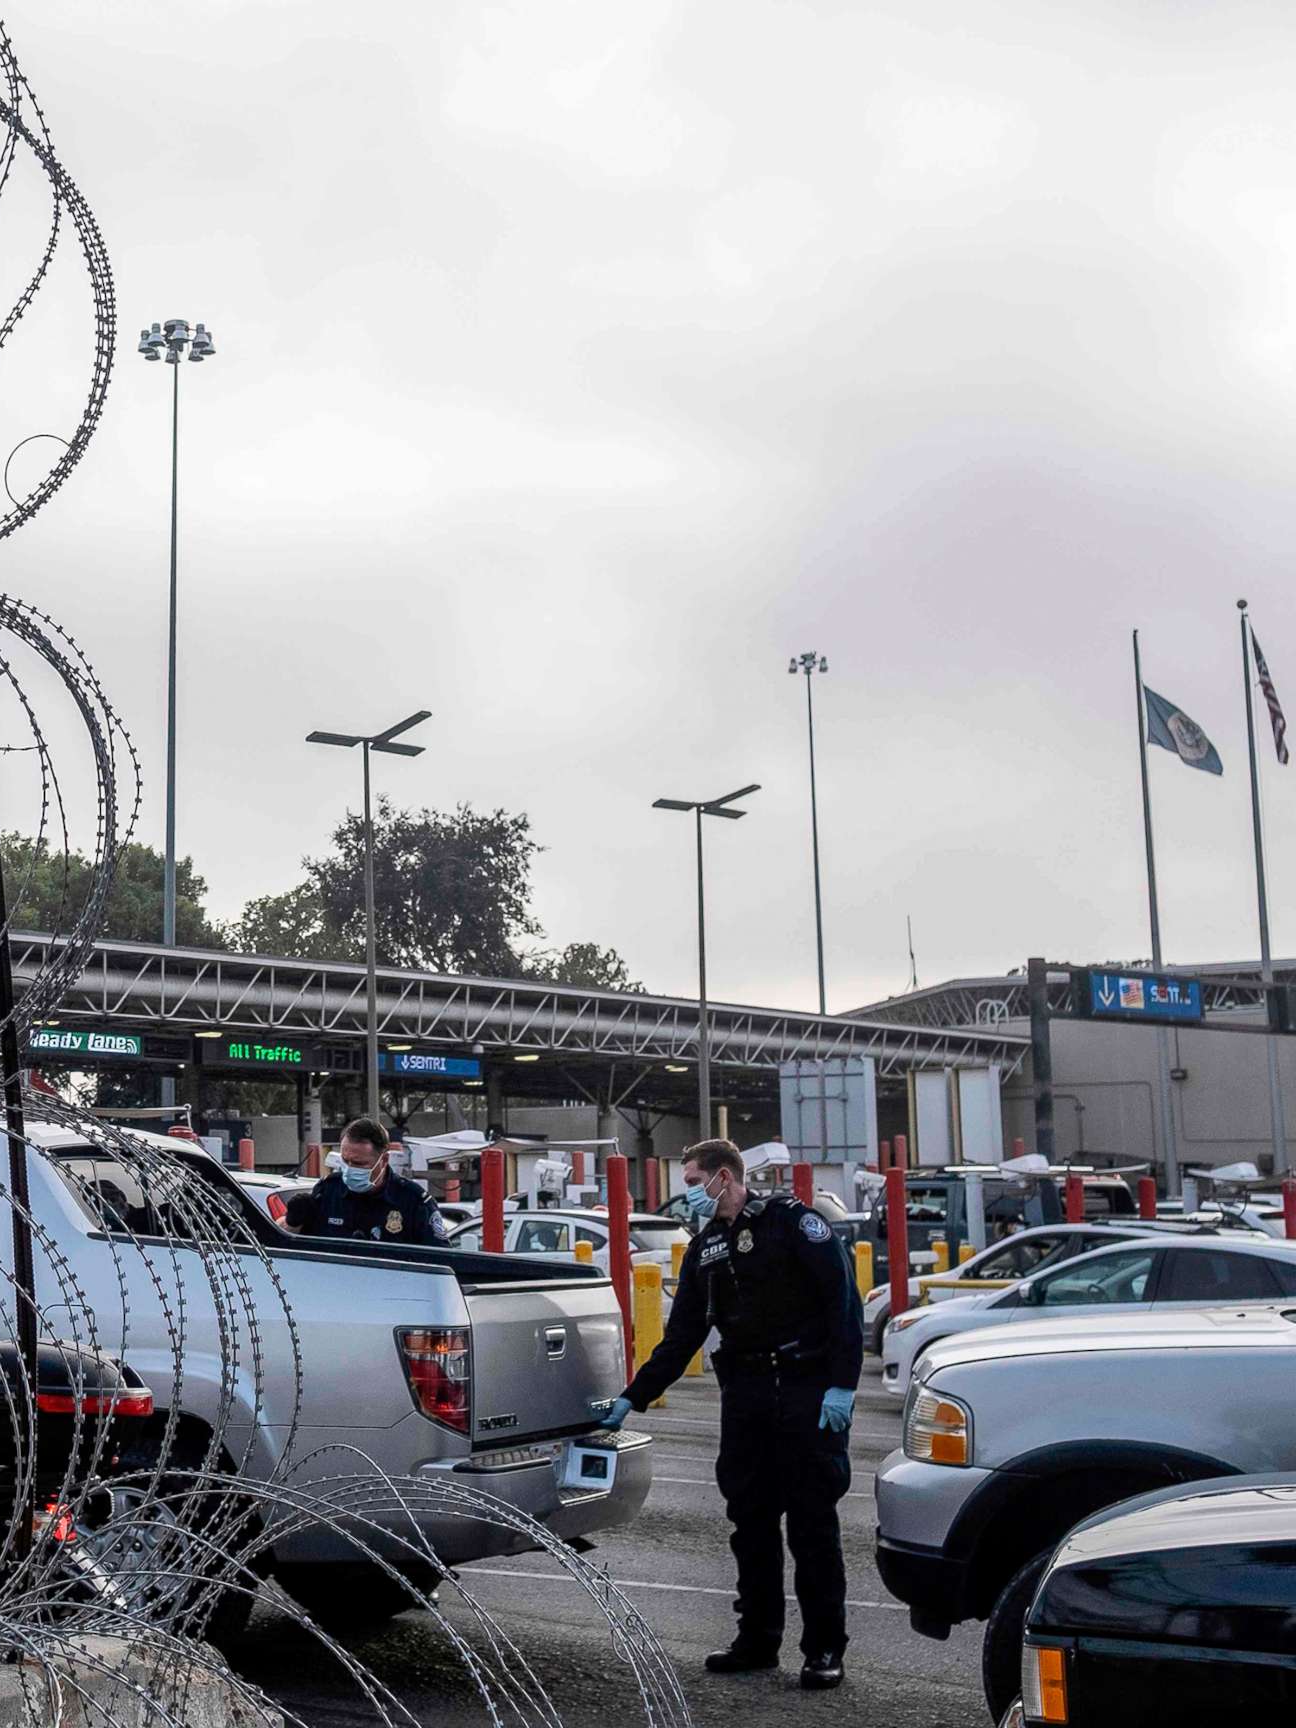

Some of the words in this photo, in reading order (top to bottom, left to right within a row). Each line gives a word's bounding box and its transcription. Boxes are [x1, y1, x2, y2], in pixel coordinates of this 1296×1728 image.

[229, 1043, 250, 1059] All
[253, 1045, 302, 1063] Traffic
[409, 1055, 447, 1071] SENTRI
[701, 1241, 728, 1259] CBP
